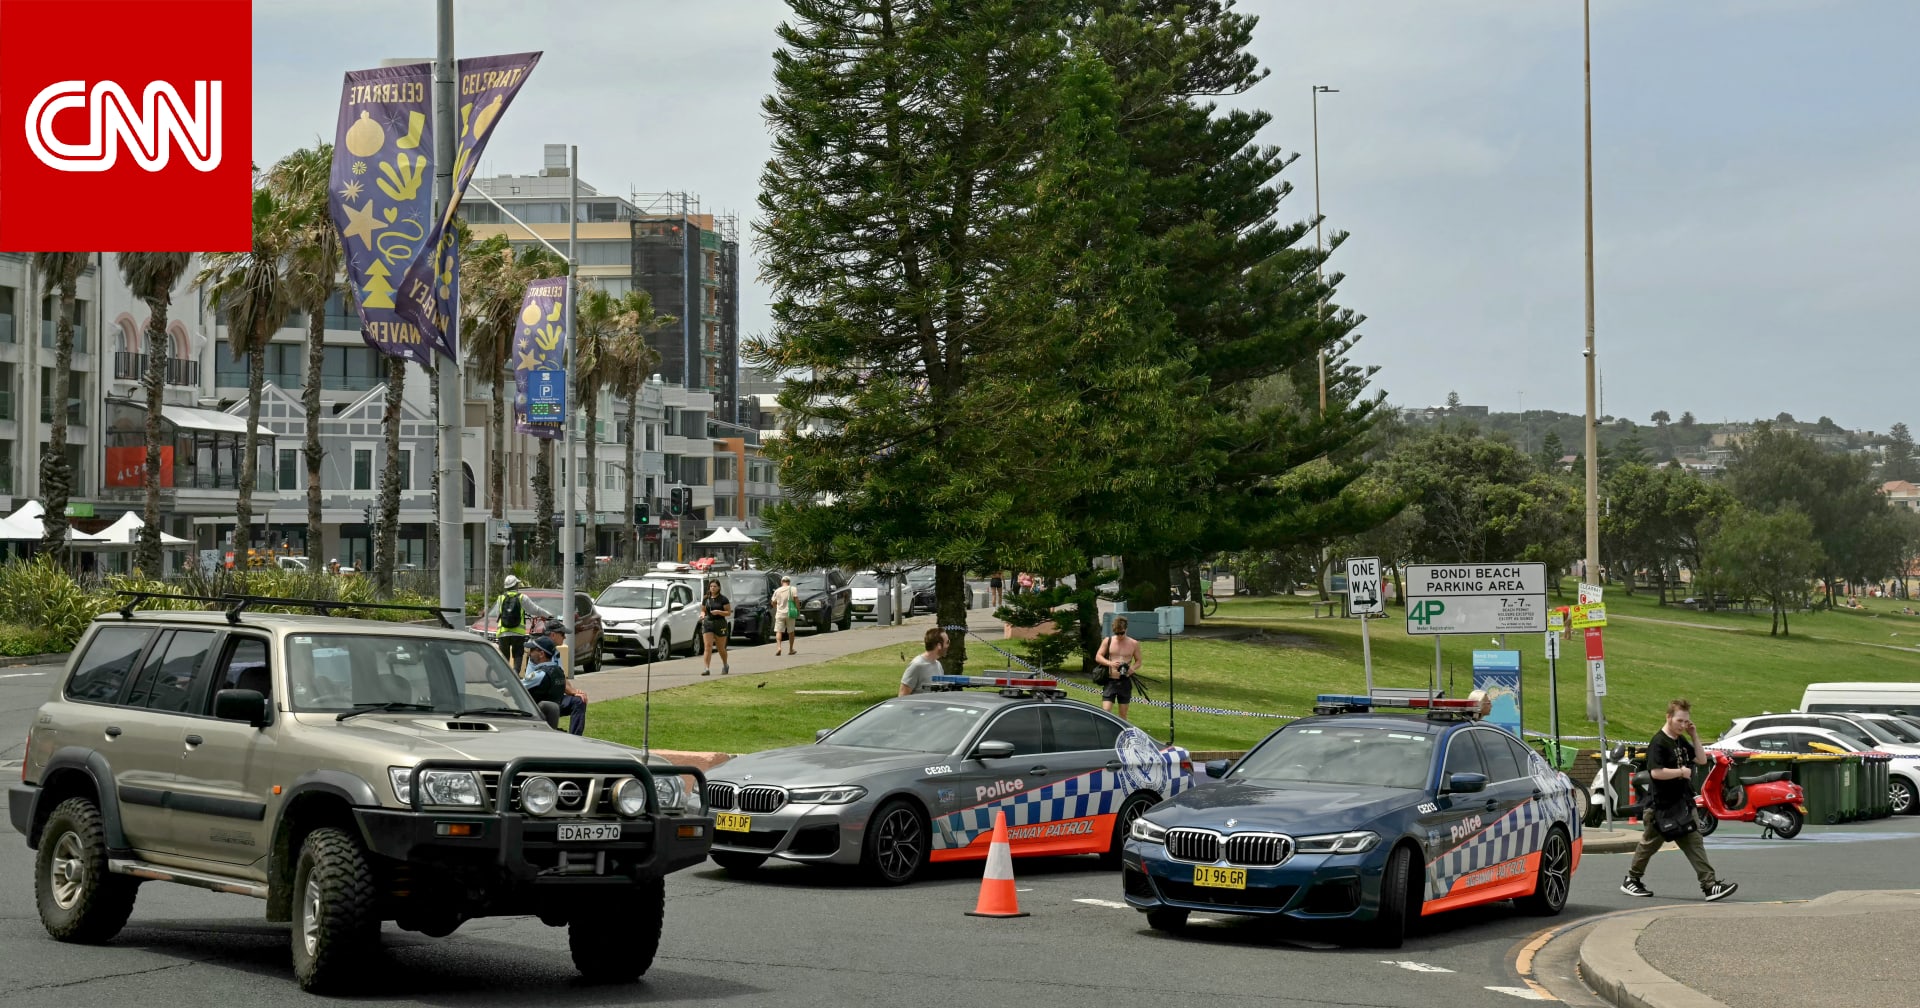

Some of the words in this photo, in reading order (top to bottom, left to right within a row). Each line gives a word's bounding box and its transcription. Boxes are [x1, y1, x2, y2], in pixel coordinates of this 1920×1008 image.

[542, 386, 550, 396] P
[1352, 562, 1376, 577] ONE
[1431, 568, 1471, 579] BONDI
[1476, 567, 1520, 578] BEACH
[1351, 579, 1377, 594] WAY
[1427, 581, 1483, 592] PARKING
[1488, 580, 1525, 591] AREA
[1408, 599, 1445, 625] 4P
[1595, 662, 1601, 672] P
[925, 765, 953, 775] CE202
[975, 778, 1024, 802] Police
[1417, 802, 1438, 814] CE213
[1045, 820, 1094, 837] PATROL
[1450, 814, 1482, 844] Police
[1196, 868, 1208, 882] DI
[1213, 870, 1227, 883] 96
[1230, 871, 1244, 885] GR
